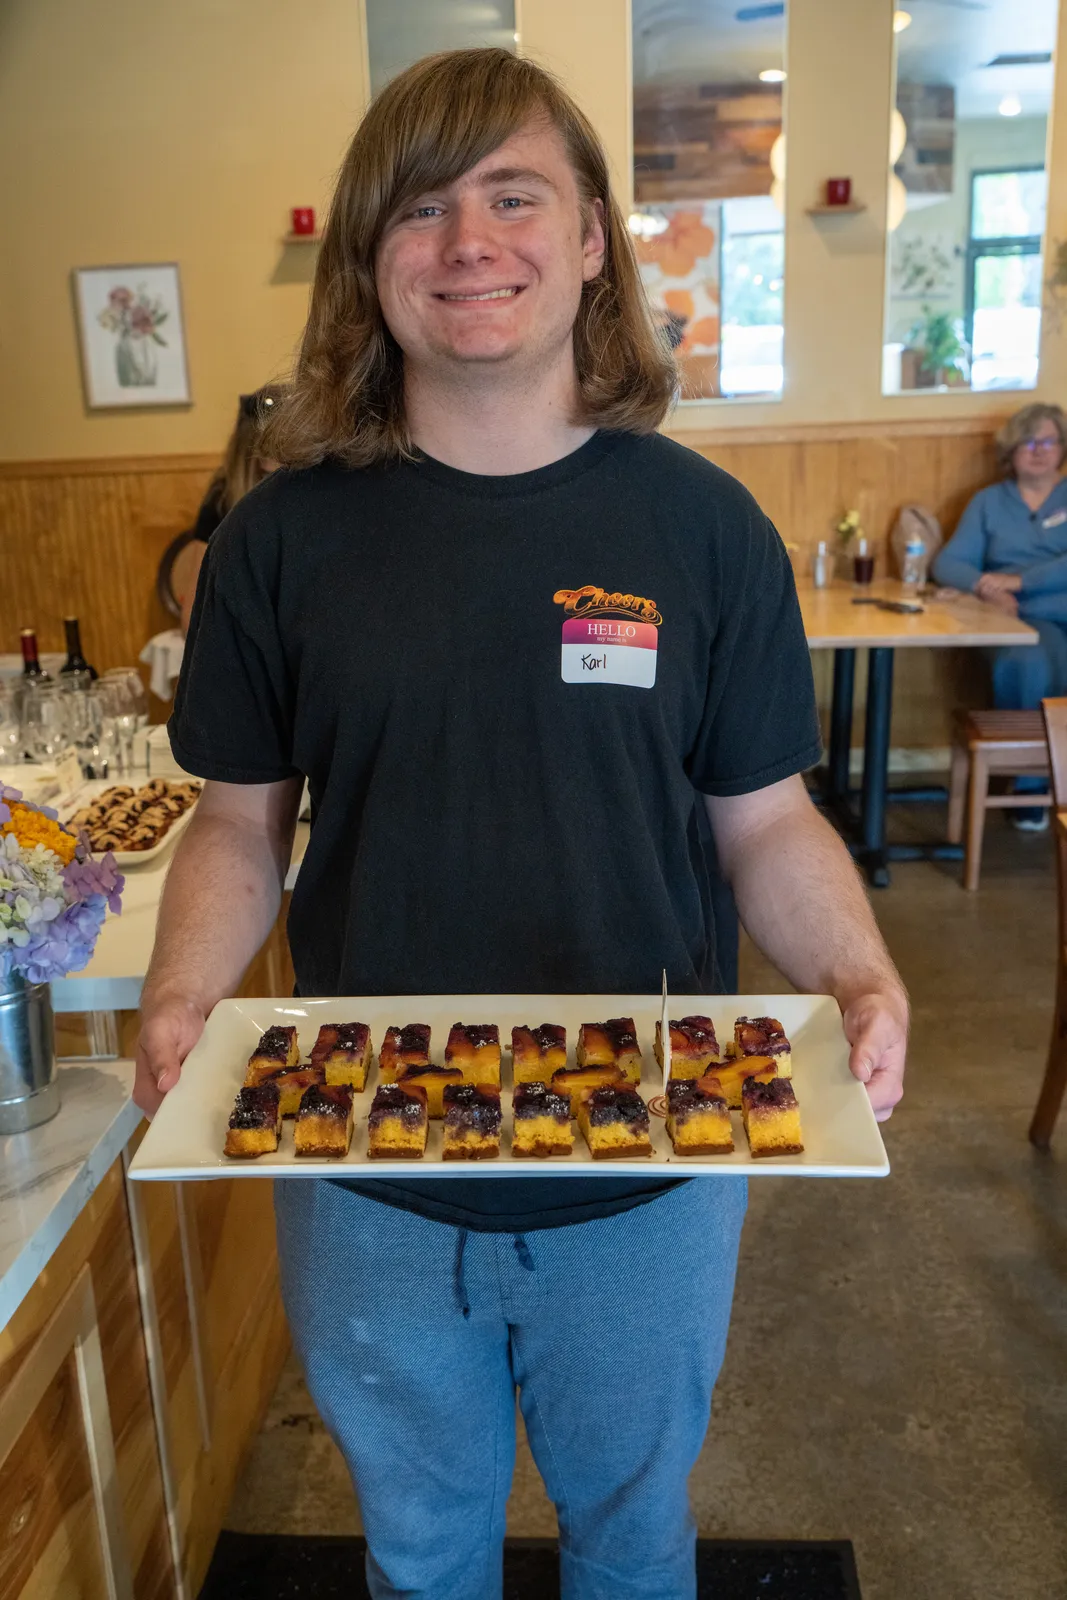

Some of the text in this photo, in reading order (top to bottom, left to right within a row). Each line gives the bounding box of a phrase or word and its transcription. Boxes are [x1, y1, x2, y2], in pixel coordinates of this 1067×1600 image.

[553, 585, 661, 622] Cheers
[587, 623, 636, 637] HELLO
[581, 653, 606, 671] Karl
